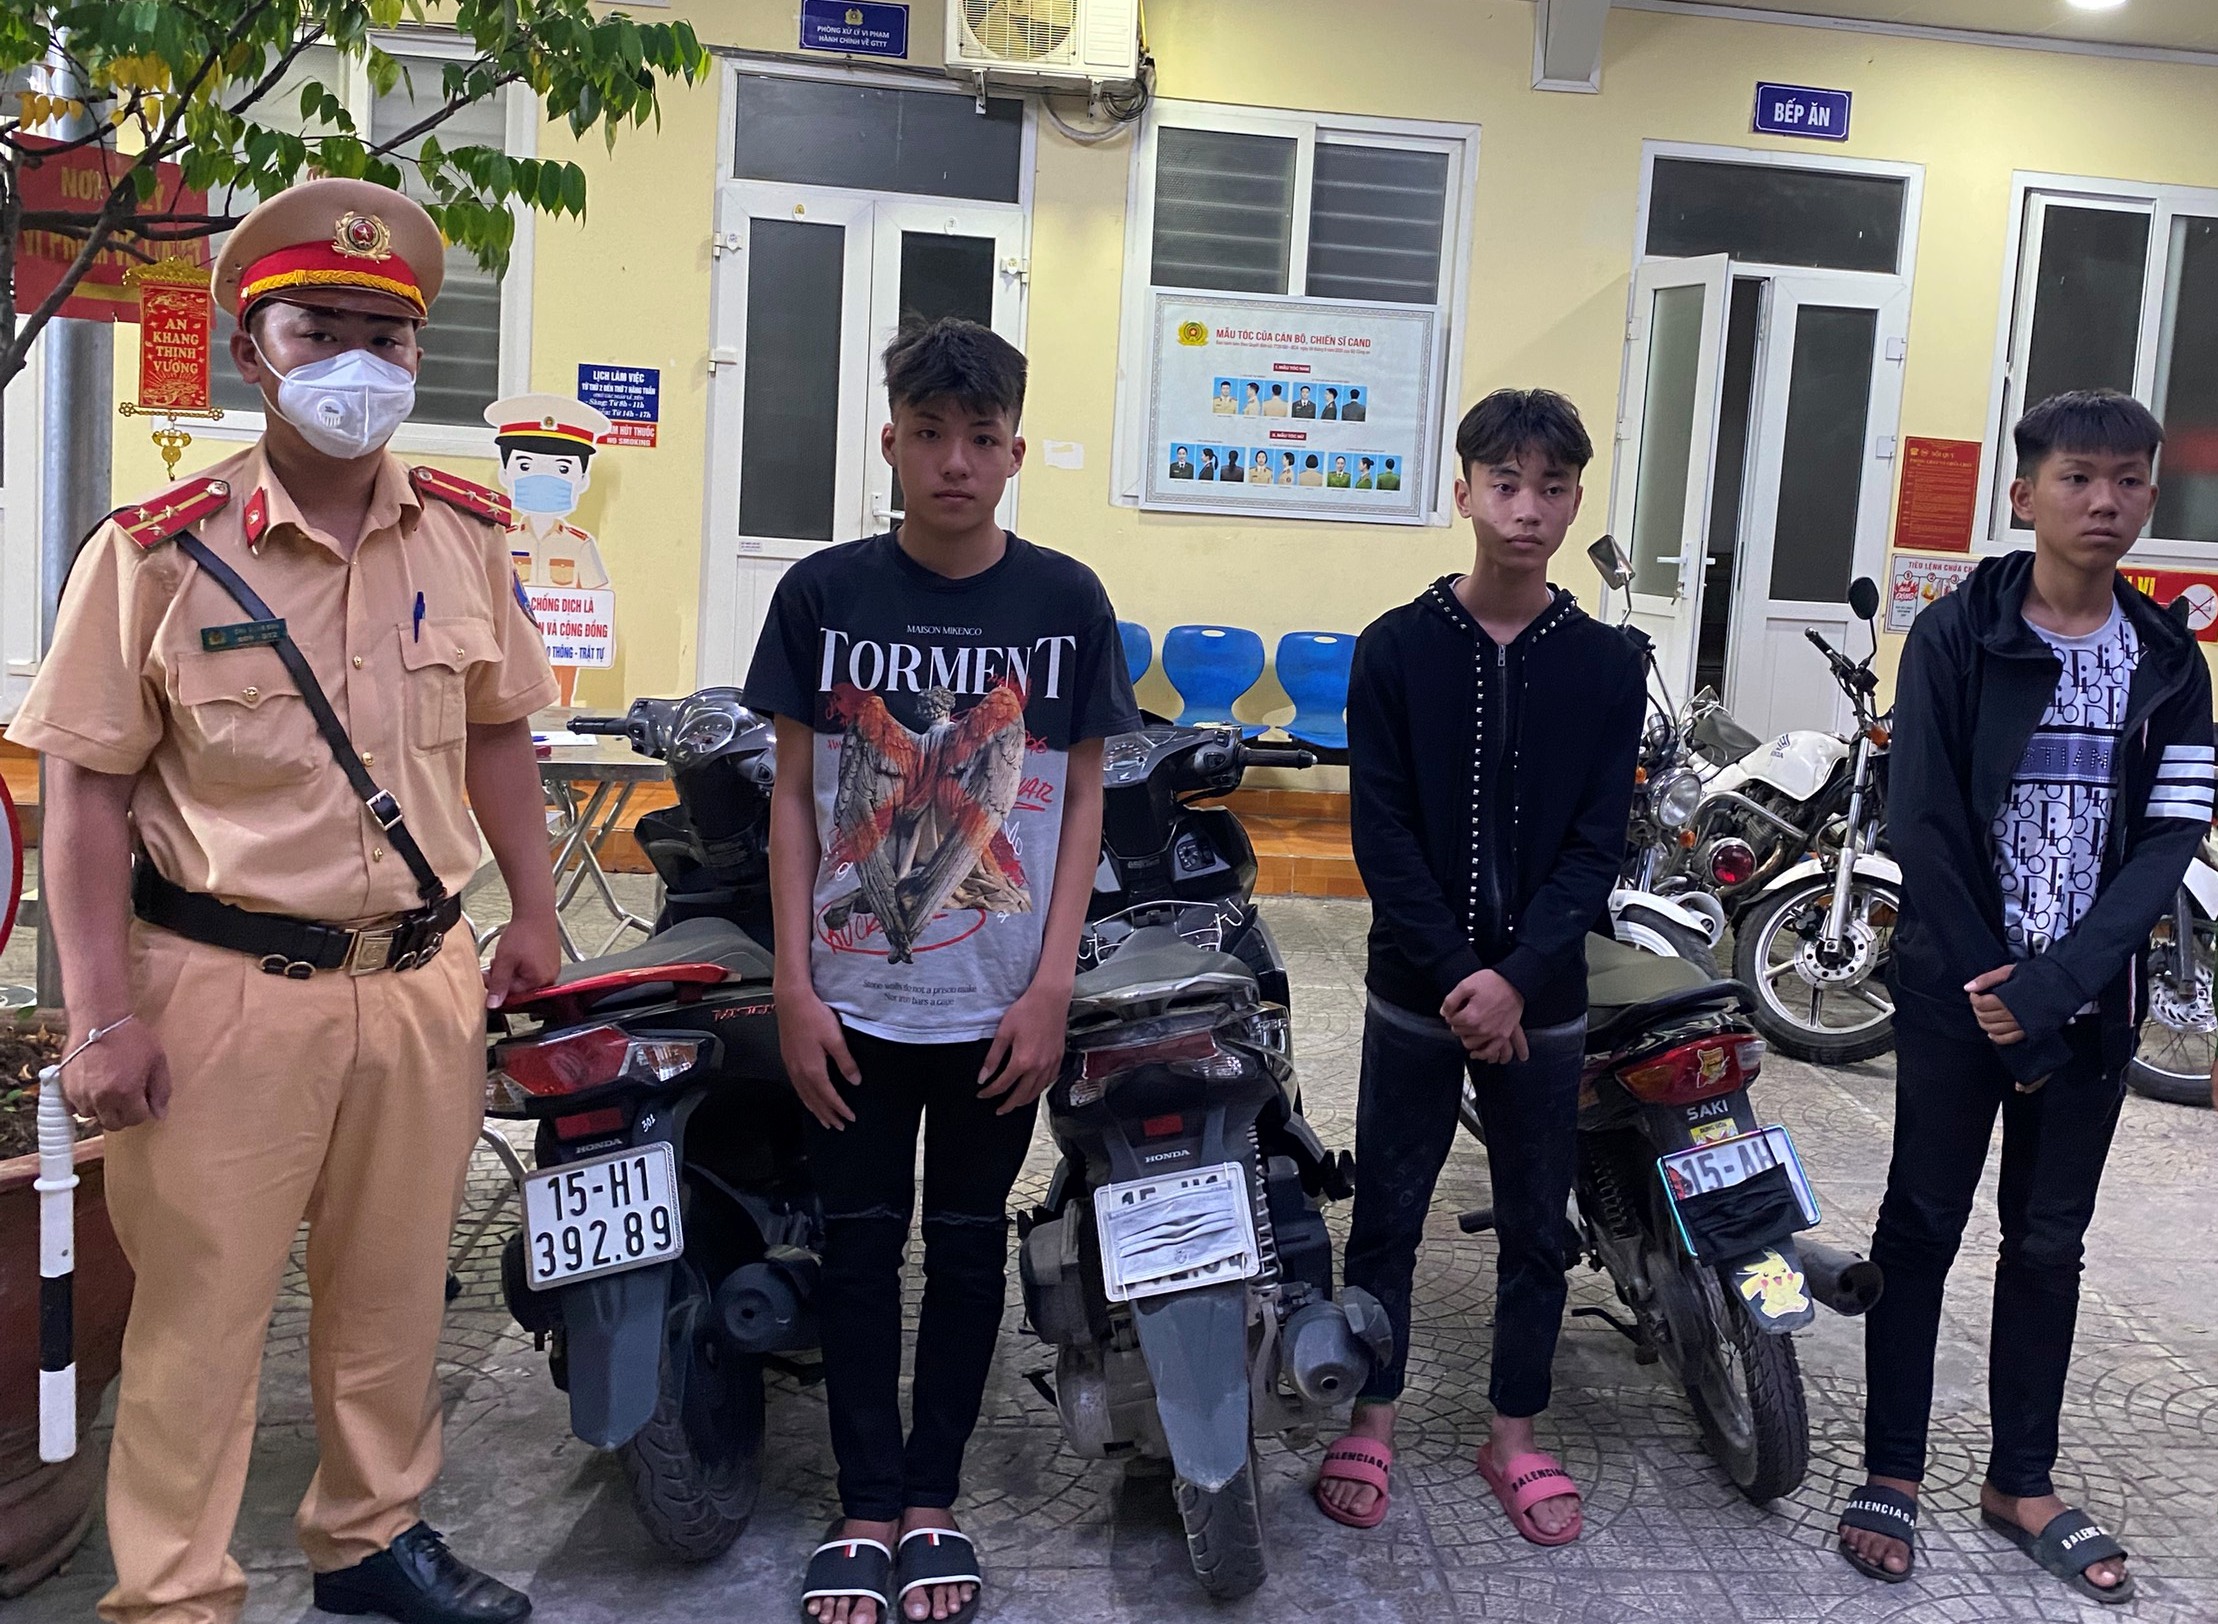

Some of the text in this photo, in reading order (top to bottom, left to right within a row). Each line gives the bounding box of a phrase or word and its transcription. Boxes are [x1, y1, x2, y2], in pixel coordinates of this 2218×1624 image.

[817, 25, 841, 34] PHÒNG
[842, 27, 853, 35] XỬ
[818, 34, 838, 43] HÀNH
[839, 36, 860, 45] CHÍNH
[1774, 97, 1831, 127] BẾP ĂN
[164, 318, 188, 330] AN
[153, 331, 199, 345] KHANG
[1216, 327, 1236, 338] MẪU
[1238, 329, 1254, 340] TÓC
[1256, 330, 1273, 341] CỦA
[1275, 332, 1292, 343] CÁN
[1310, 334, 1336, 345] CHIẾN
[1338, 335, 1347, 346] SĨ
[1348, 338, 1371, 348] CAND
[155, 345, 196, 360] THỊNH
[593, 370, 645, 384] LỊCH LÀM VIỆC
[639, 411, 651, 419] 17h
[620, 424, 633, 436] HÚT
[633, 425, 655, 438] THUỐC
[618, 438, 651, 446] SMOKING
[1925, 562, 1941, 571] LỆNH
[531, 593, 594, 615] CHỐNG DỊCH LÀ
[547, 619, 557, 635] VÀ
[560, 620, 582, 639] CỘNG
[907, 624, 983, 636] MAISON MIKENCO
[552, 644, 573, 658] THÔNG
[579, 645, 595, 662] TRẬT
[596, 647, 605, 662] TỰ
[818, 627, 1077, 700] TORMENT
[2023, 747, 2108, 769] STIAN
[933, 985, 956, 996] prison
[912, 997, 929, 1006] bars
[1686, 1099, 1729, 1121] SAKI
[576, 1138, 623, 1154] HONDA
[1145, 1149, 1191, 1164] HONDA
[548, 1157, 649, 1221] 15-H1
[535, 1206, 672, 1277] 392.89
[1512, 1468, 1569, 1493] BALENCI
[2061, 1526, 2110, 1550] BALEN
